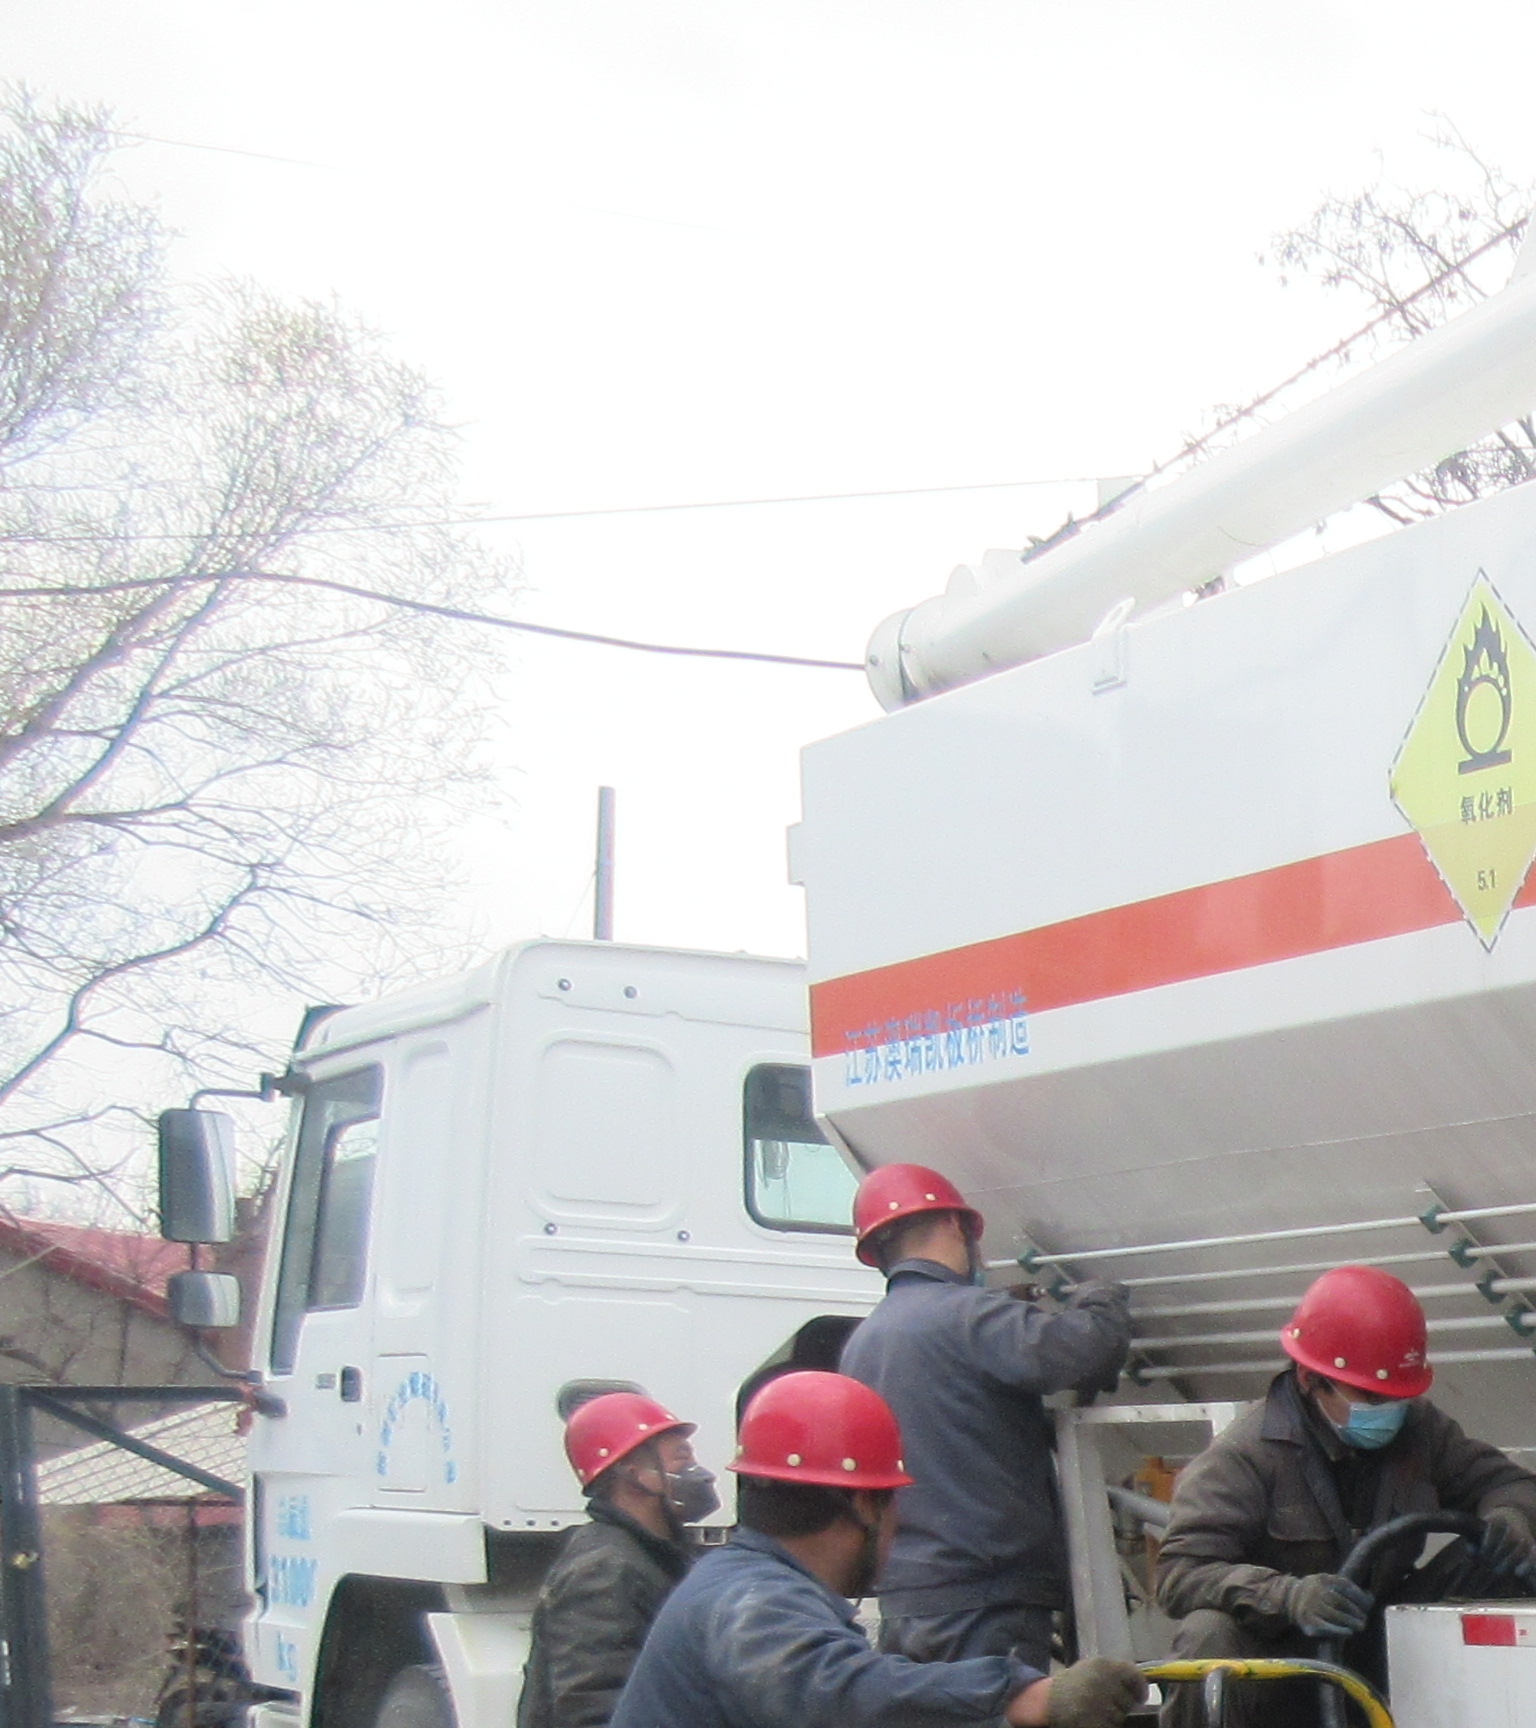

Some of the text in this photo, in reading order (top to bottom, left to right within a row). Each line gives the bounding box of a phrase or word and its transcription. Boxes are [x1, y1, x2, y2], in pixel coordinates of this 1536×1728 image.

[1461, 787, 1512, 824] 氧化剂
[1477, 869, 1496, 890] 5.1
